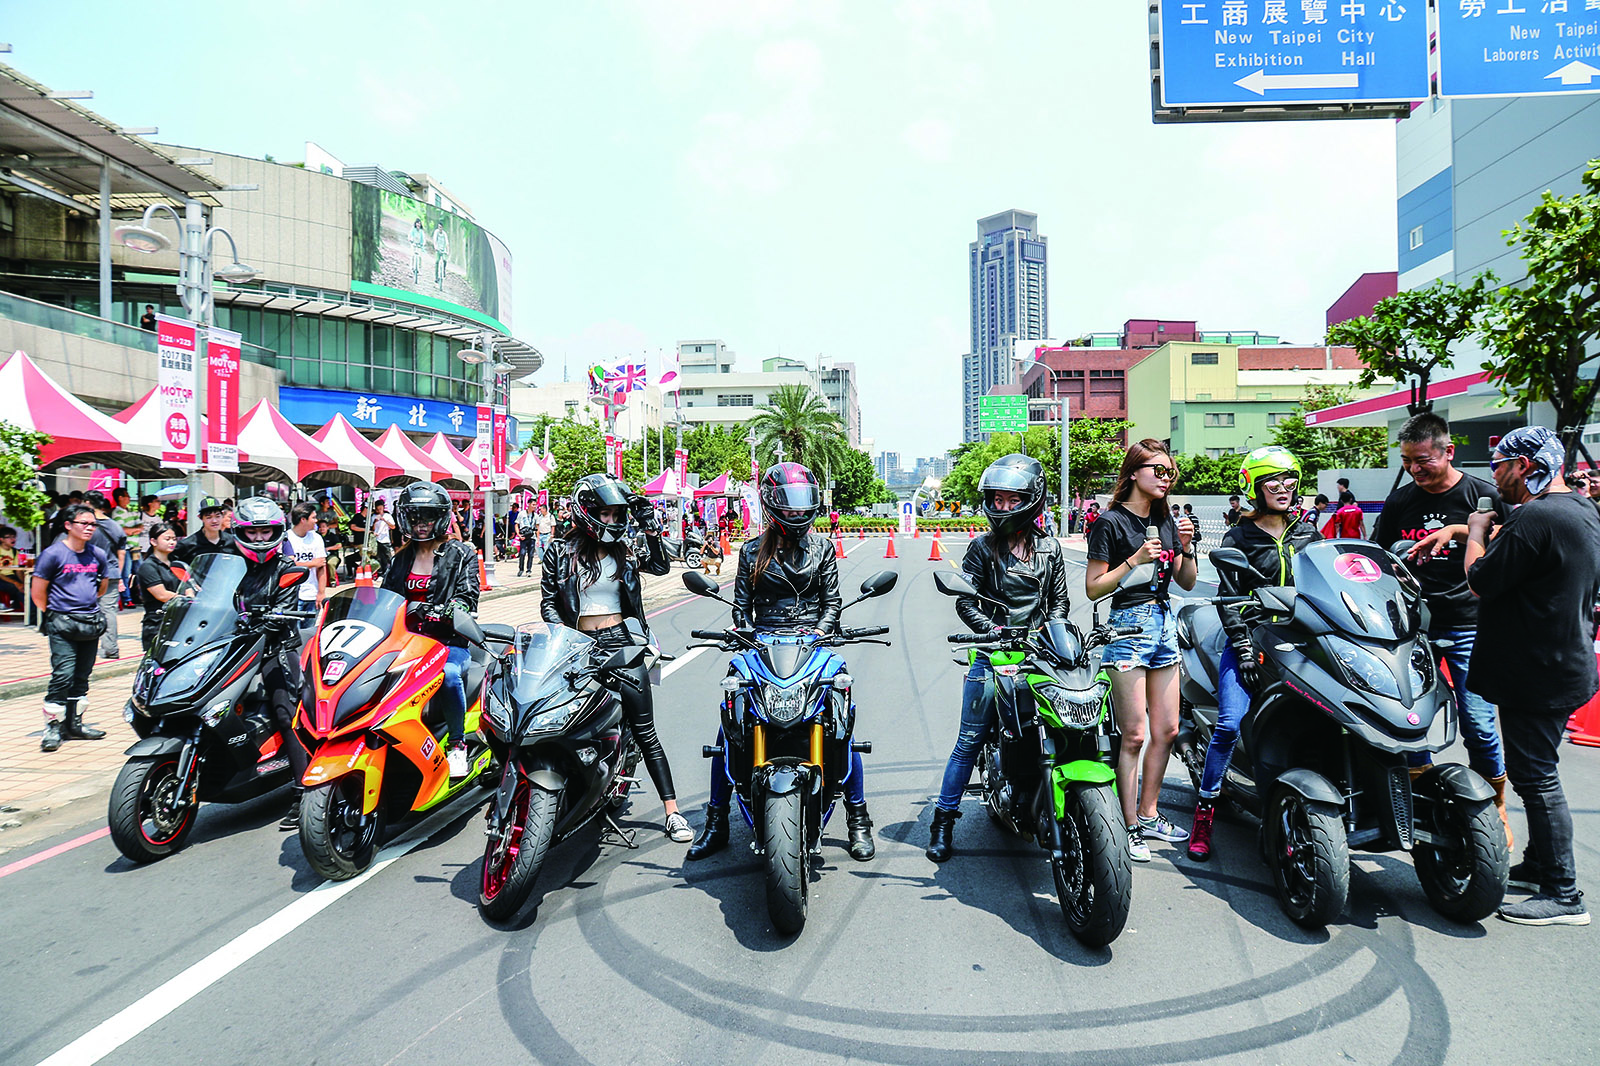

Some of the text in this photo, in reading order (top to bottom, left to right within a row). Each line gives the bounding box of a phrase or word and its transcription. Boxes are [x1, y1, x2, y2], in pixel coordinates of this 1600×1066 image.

[1214, 29, 1375, 46] New Taipei City
[1510, 21, 1598, 41] New Taipei
[1215, 51, 1375, 68] Exhibition Hall
[1484, 48, 1540, 62] Laborers
[161, 349, 180, 360] 2017
[209, 356, 238, 370] MOTOR
[160, 385, 193, 399] MOTOR
[352, 396, 466, 432] 新北市
[324, 625, 367, 651] 77
[414, 647, 446, 678] MALOSSI
[421, 678, 442, 698] KYMCO
